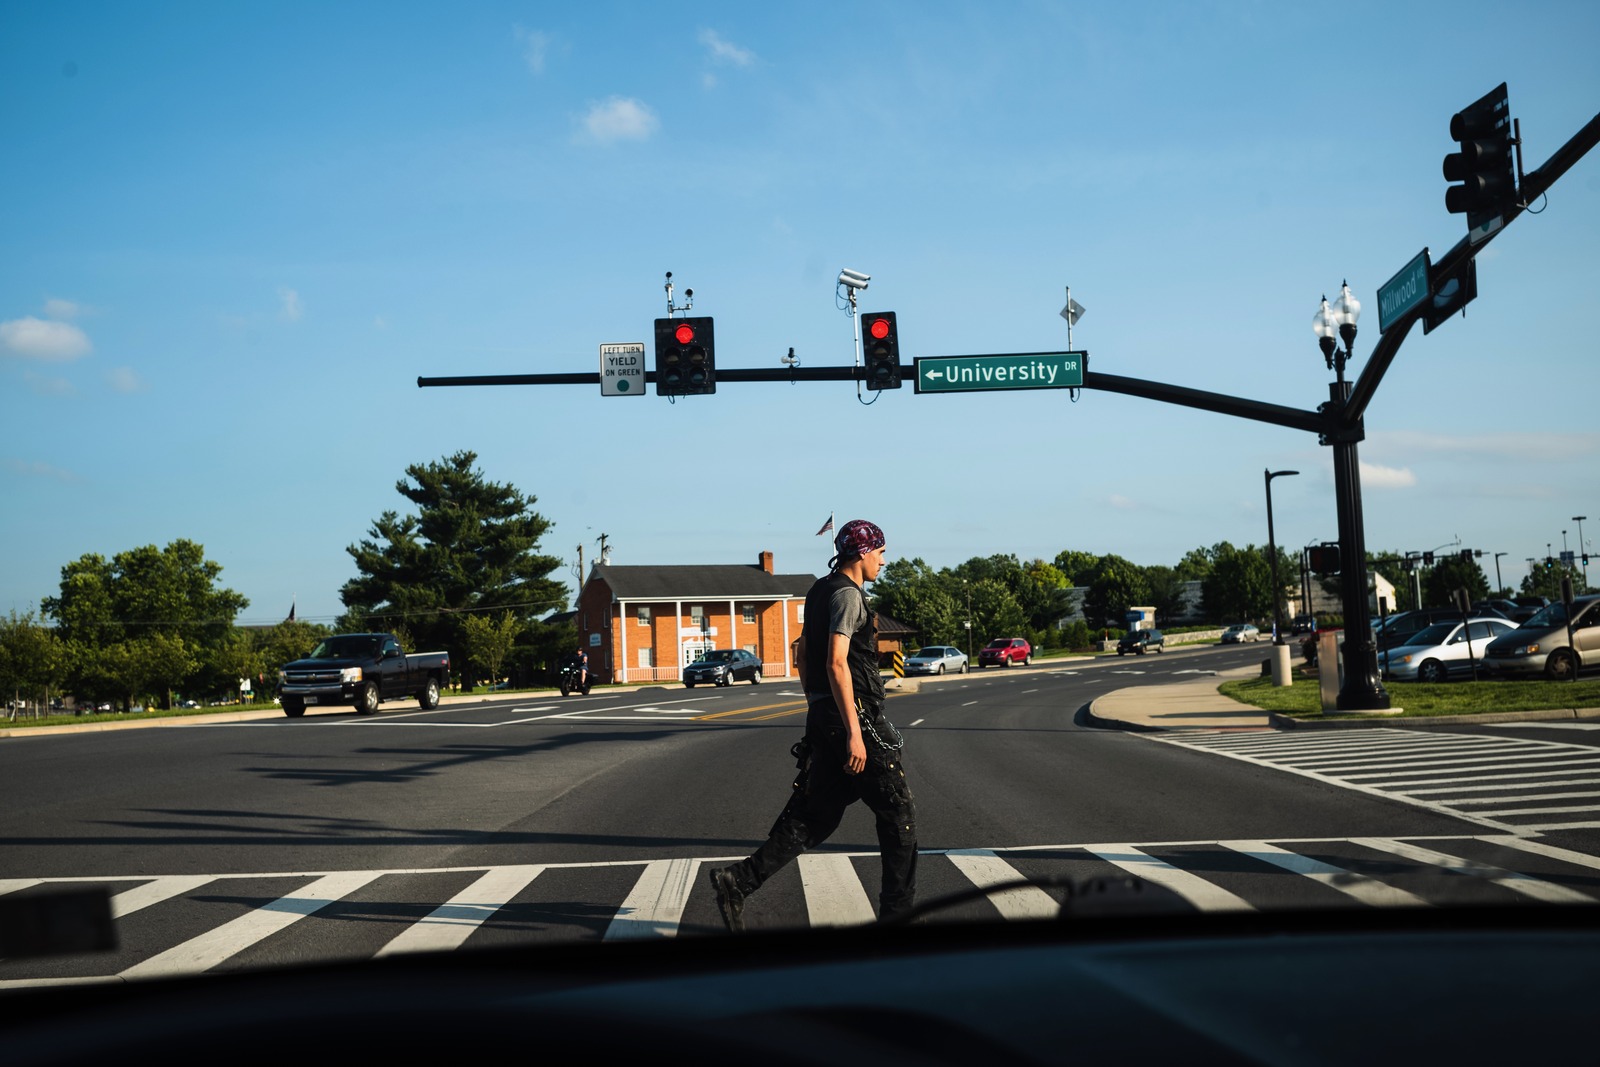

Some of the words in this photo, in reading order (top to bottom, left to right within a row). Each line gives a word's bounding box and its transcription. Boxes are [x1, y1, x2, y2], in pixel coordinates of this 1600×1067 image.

[1381, 271, 1416, 318] Millwood
[604, 346, 620, 354] LEFT
[623, 346, 641, 354] TURN
[608, 357, 636, 366] YIELD
[946, 361, 1058, 384] University
[1065, 361, 1077, 371] DR
